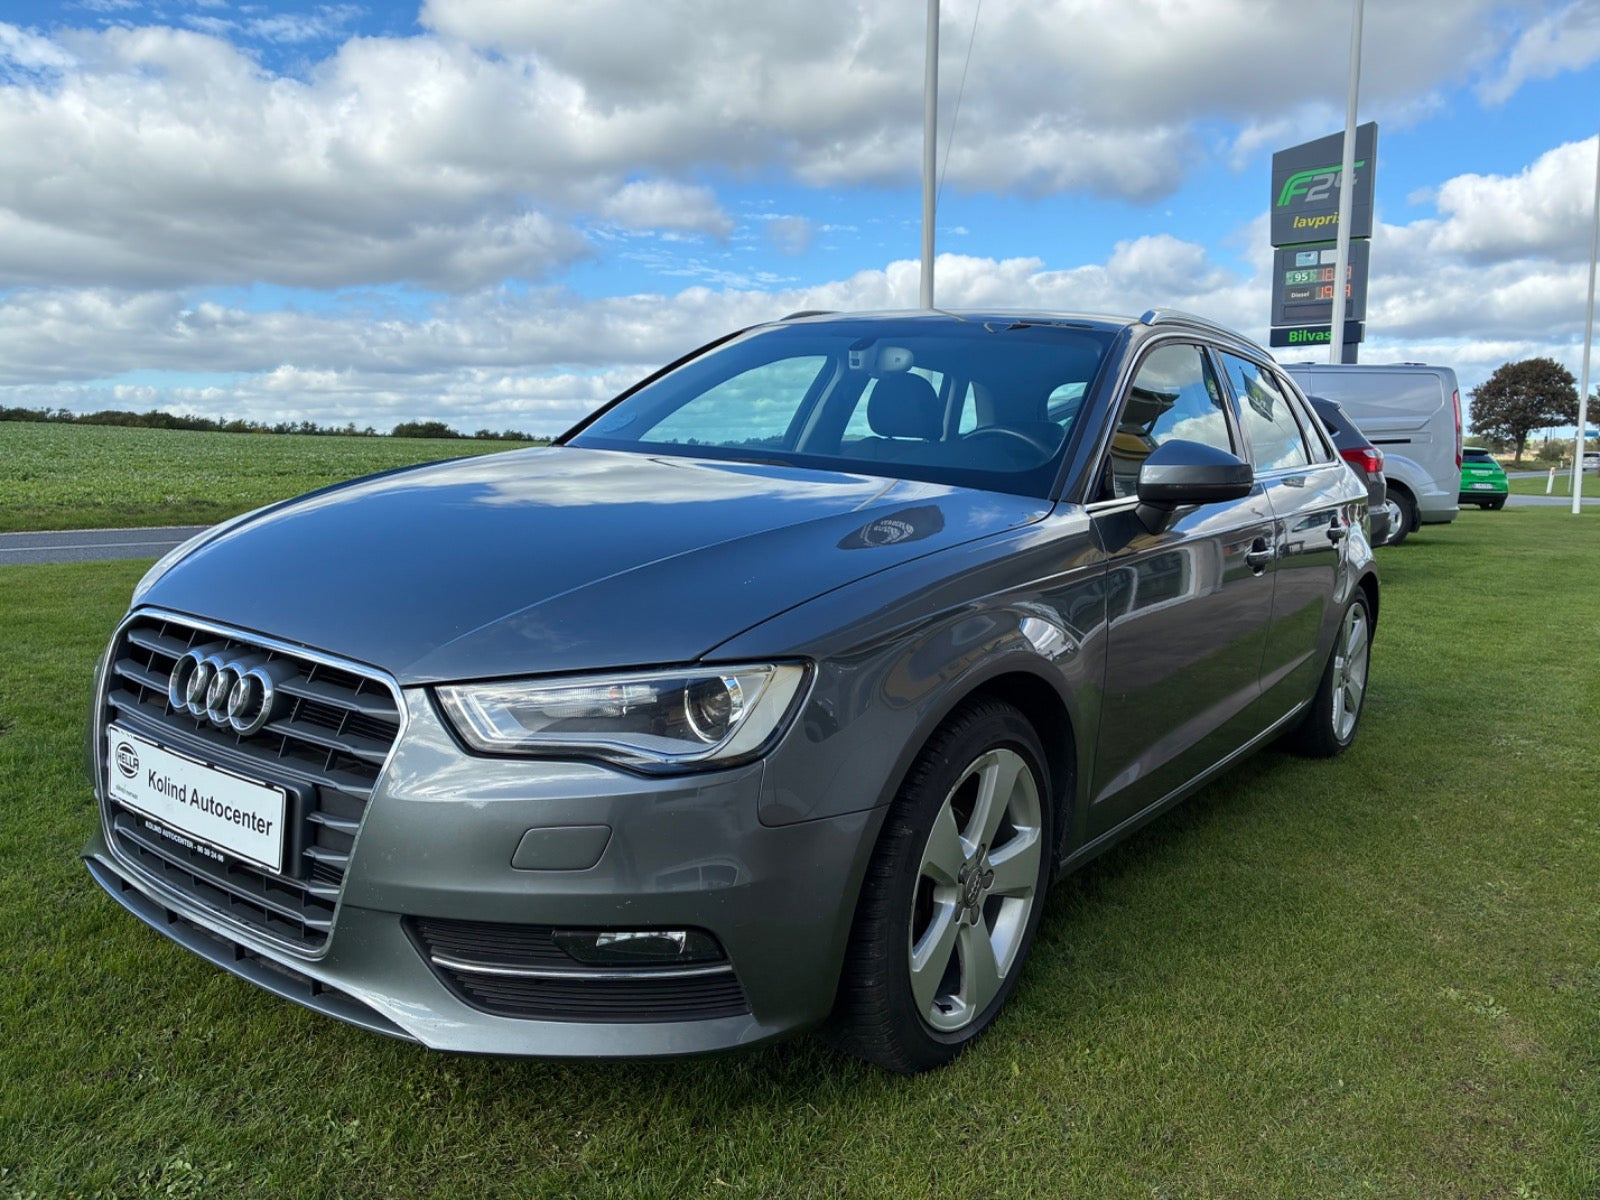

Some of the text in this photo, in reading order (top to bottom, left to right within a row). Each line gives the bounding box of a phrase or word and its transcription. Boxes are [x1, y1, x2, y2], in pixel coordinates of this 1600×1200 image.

[1294, 272, 1308, 282] 95
[1291, 291, 1310, 299] Diesel
[117, 752, 140, 772] HELLA
[148, 768, 273, 836] Kolind Autocenter
[162, 828, 194, 849] AUTOCENTER
